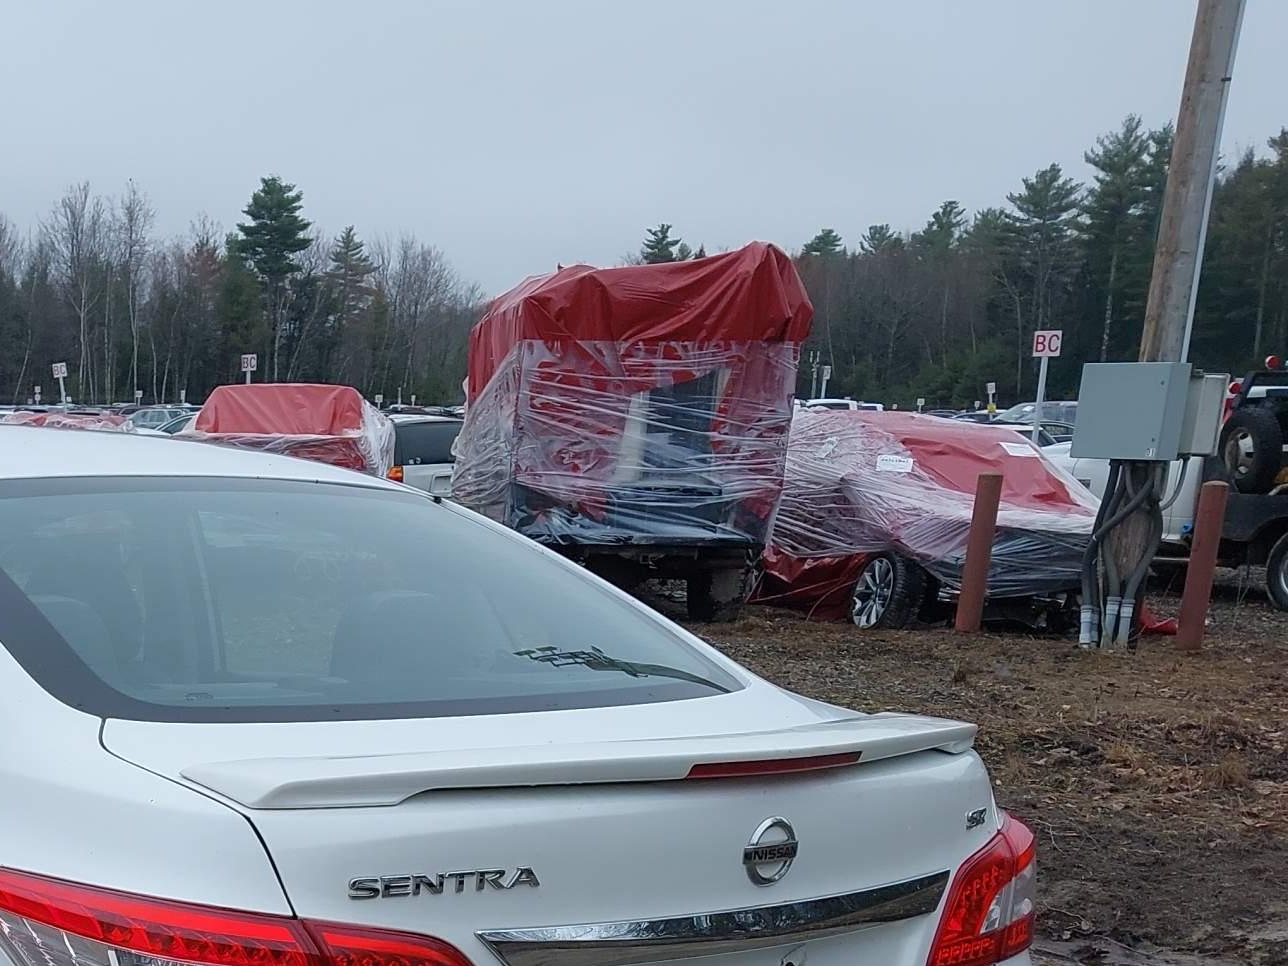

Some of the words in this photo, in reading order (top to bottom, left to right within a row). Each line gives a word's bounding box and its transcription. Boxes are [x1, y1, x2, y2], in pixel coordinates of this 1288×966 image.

[1035, 334, 1060, 352] BC
[242, 356, 256, 369] BC
[752, 845, 794, 861] NISSAN
[347, 865, 541, 901] SENTRA
